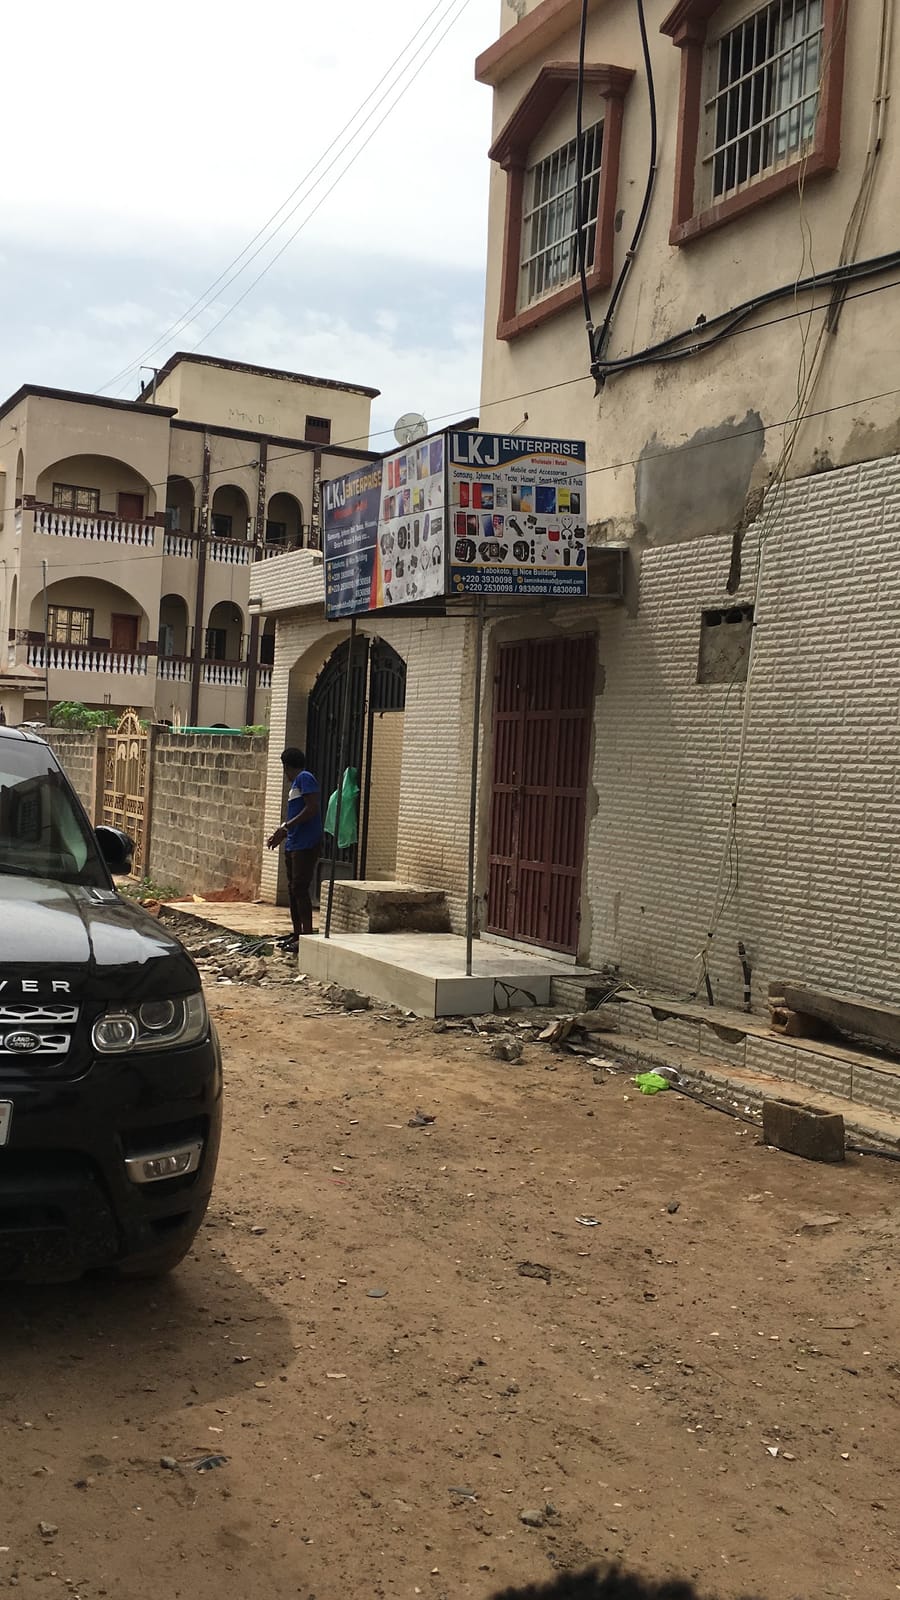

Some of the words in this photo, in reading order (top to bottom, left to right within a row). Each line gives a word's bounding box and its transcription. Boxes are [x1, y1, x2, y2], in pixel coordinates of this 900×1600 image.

[453, 433, 500, 465] LKJ
[502, 438, 579, 455] ENTERPRISE
[510, 466, 527, 474] Mobile
[538, 468, 568, 476] Accessories
[326, 480, 346, 510] LKJ
[345, 470, 382, 498] ENTERPRISE
[533, 569, 556, 578] Building
[462, 575, 480, 583] +220
[484, 584, 514, 592] 2530098
[552, 586, 581, 594] 6830098
